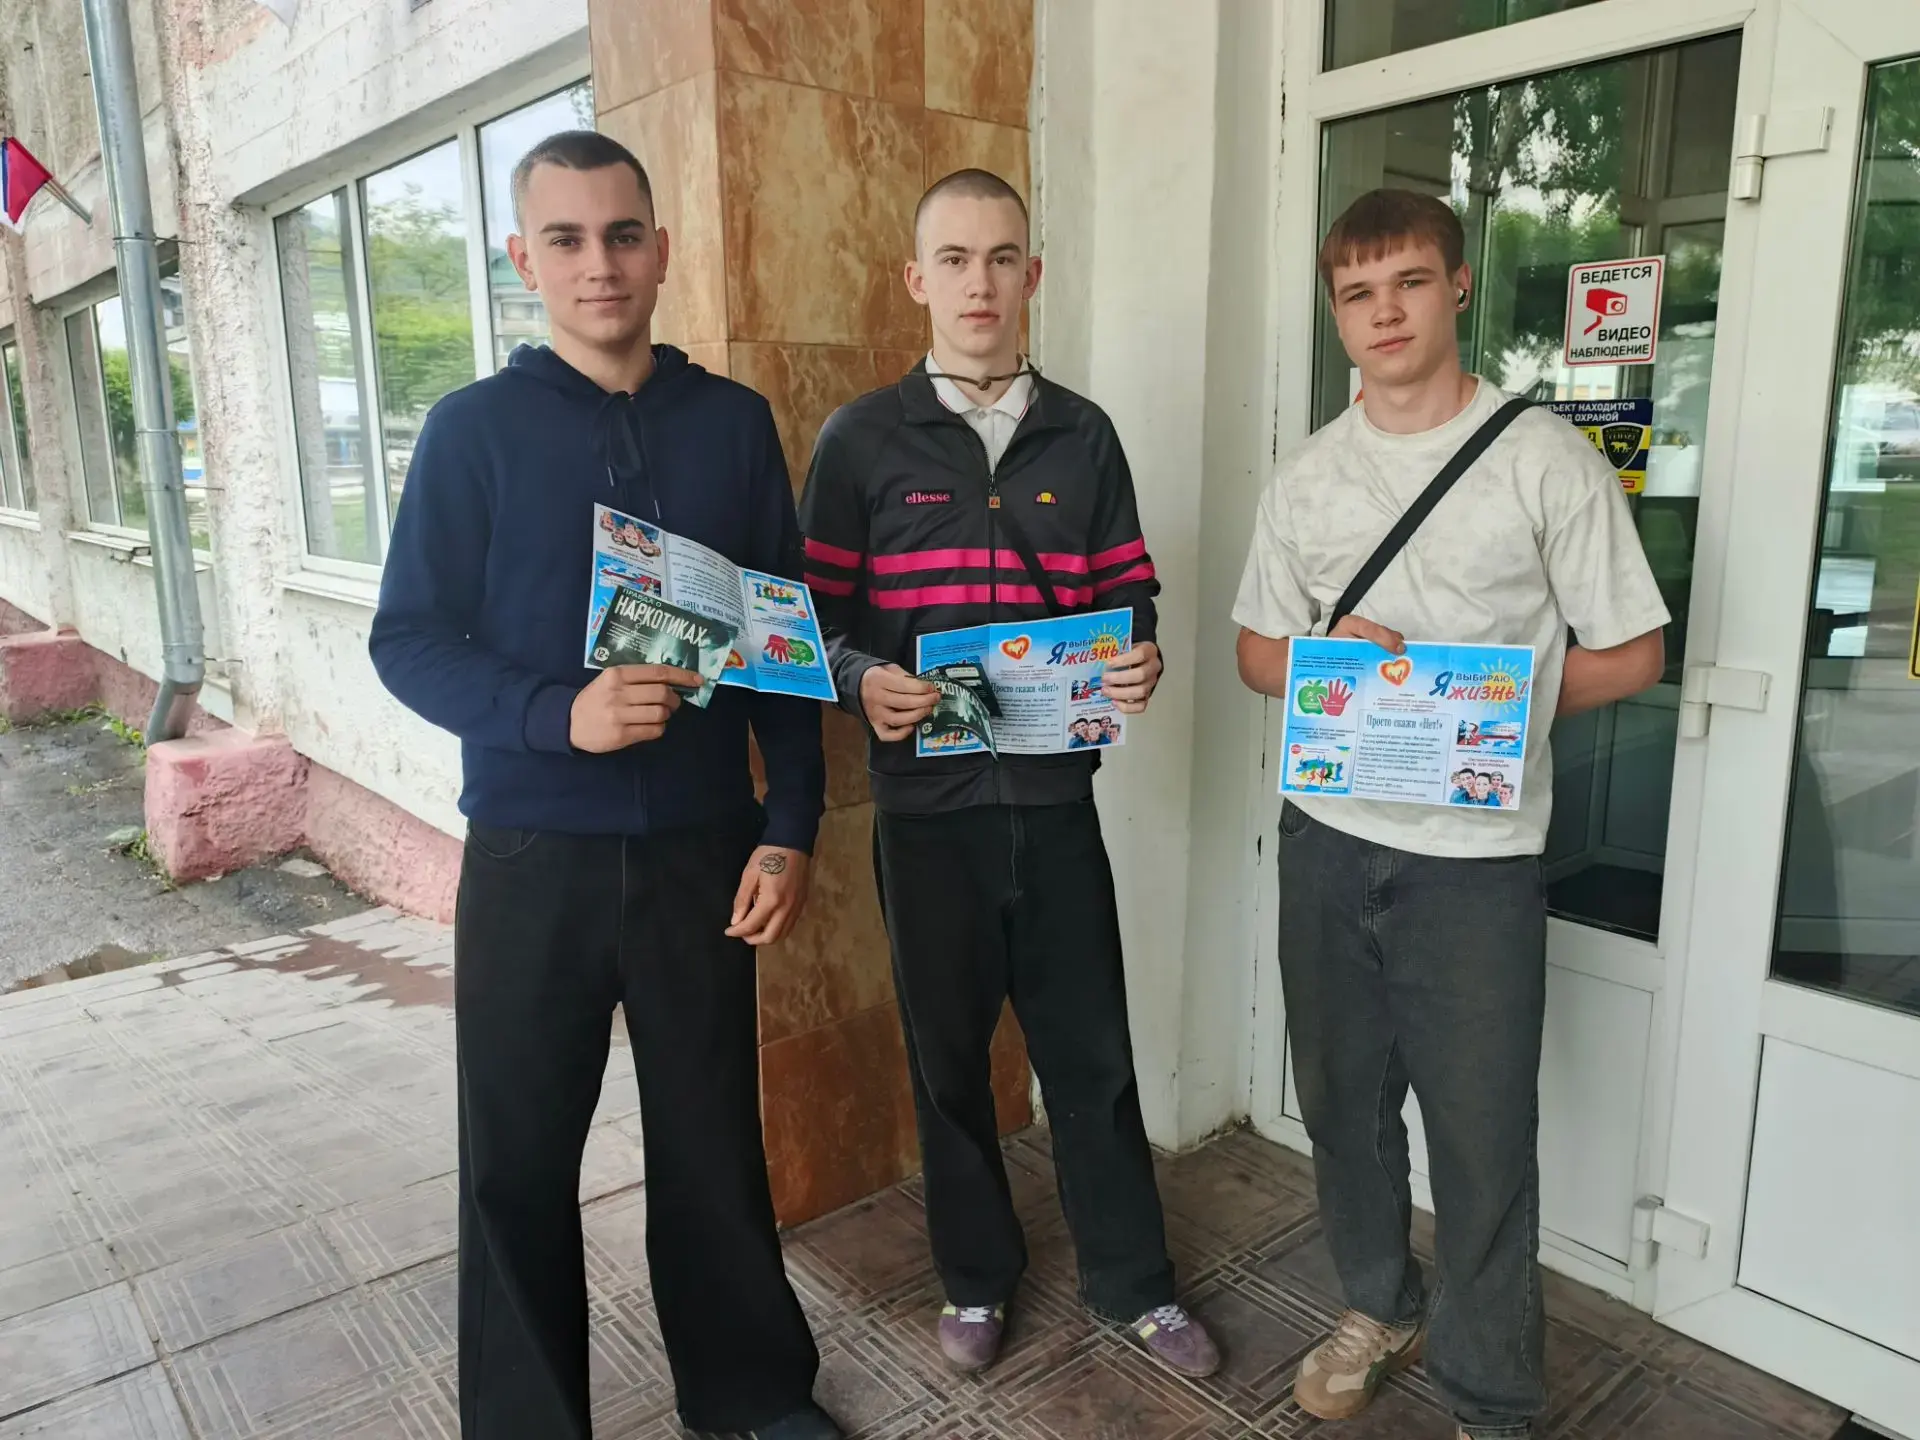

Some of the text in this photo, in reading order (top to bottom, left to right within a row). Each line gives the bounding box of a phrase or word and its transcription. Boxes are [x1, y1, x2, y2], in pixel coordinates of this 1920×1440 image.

[1581, 265, 1652, 284] ВЕДЕТСЯ
[1598, 326, 1651, 342] ВИДЕО
[1570, 343, 1650, 358] НАБЛЮДЕНИЕ
[1578, 402, 1635, 413] НАХОДИТСЯ
[1558, 412, 1619, 423] ОД ОХРАНОЙ
[905, 491, 951, 504] ellesse
[622, 588, 655, 605] ПРАВДА
[614, 594, 708, 648] НАРКОТИКАХ
[1046, 637, 1114, 665] Я ВЫБИРАЮ
[1428, 670, 1511, 697] Я ВЫБИРАЮ
